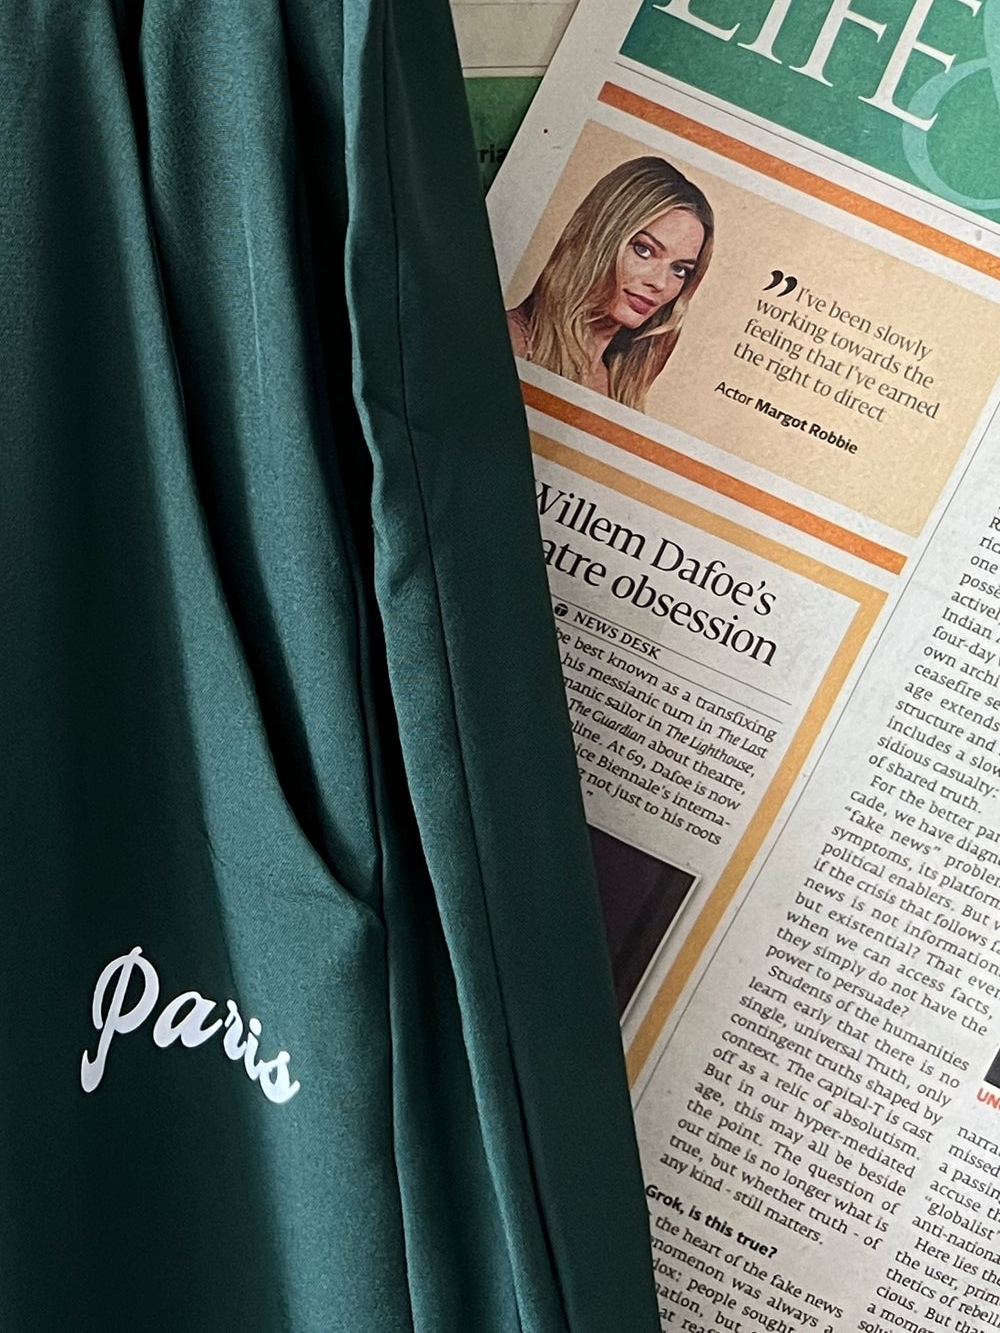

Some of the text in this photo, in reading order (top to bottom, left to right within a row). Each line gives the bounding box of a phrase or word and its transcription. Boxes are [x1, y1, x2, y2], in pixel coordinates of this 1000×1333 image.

[757, 299, 934, 389] working towards the
[795, 287, 933, 362] I've been slowly
[733, 341, 887, 423] the right to direct
[744, 318, 941, 420] feeling that I've earned
[714, 381, 858, 455] Actor Margot Robbie
[611, 566, 778, 666] obsession
[650, 537, 777, 617] Dafoe's
[573, 611, 662, 660] NEWS DESK
[932, 625, 997, 664] four-day
[941, 606, 993, 640] Indian
[562, 652, 769, 759] his messianic turn in The Last
[574, 636, 778, 743] best known as a transfixing
[895, 700, 965, 738] structure
[914, 664, 982, 702] ceasefire
[568, 697, 745, 796] The Guardian about theatre,
[606, 740, 741, 810] At 69, Dafoe is now
[886, 715, 952, 755] includes
[586, 773, 722, 845] not just to his roots
[765, 944, 910, 1018] power to persuade?
[777, 927, 988, 1036] they simply do not have the
[787, 911, 946, 992] when we can access
[81, 946, 300, 1104] Paris
[739, 996, 787, 1028] single,
[794, 1021, 863, 1063] universal
[865, 1053, 911, 1090] Truth,
[917, 1084, 952, 1108] only
[722, 1031, 934, 1143] context. The capital-T is cast
[646, 1184, 778, 1259] Grok, is this true?
[659, 1153, 823, 1245] any kind still matters.
[655, 1216, 802, 1298] the heart of the fake
[914, 1237, 979, 1276] Here lies
